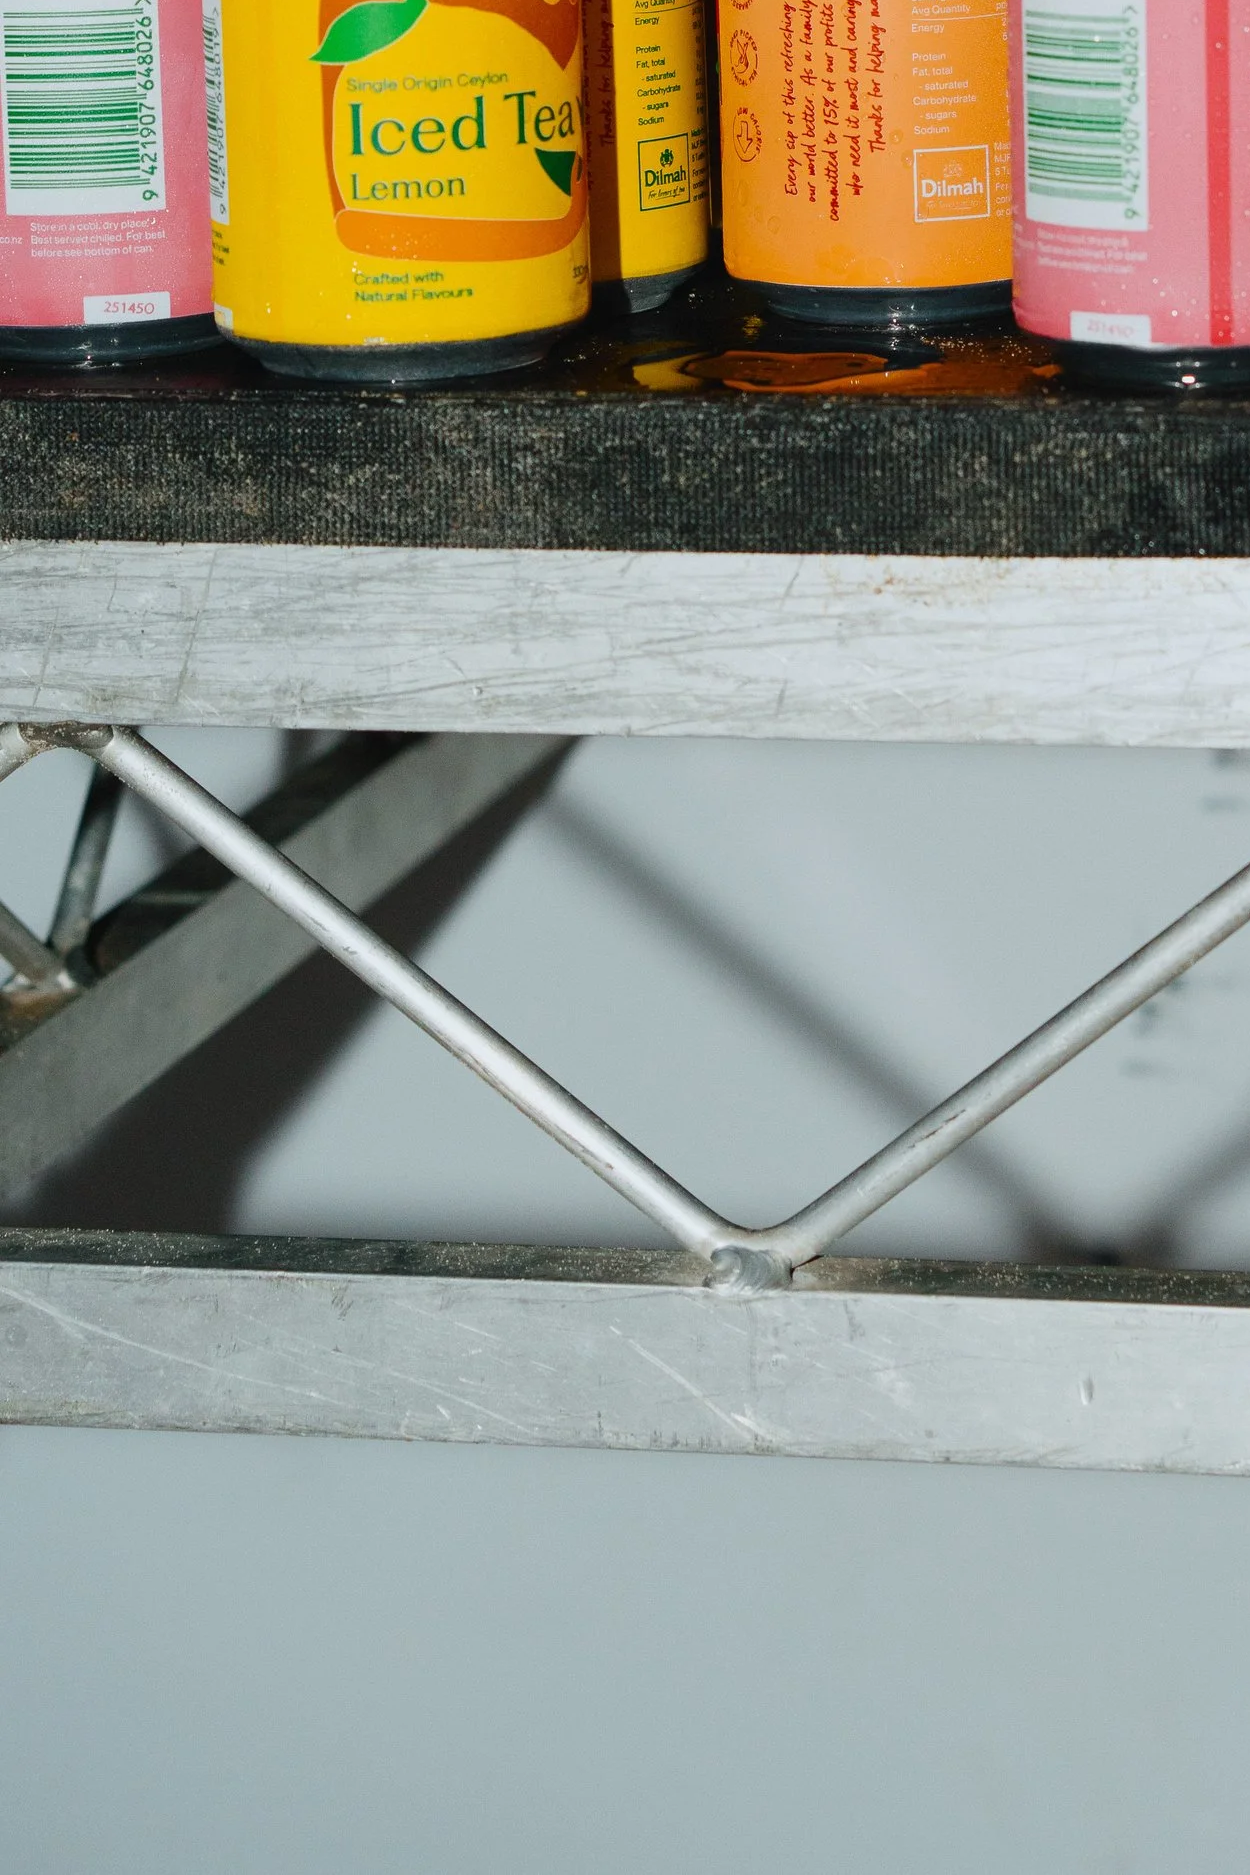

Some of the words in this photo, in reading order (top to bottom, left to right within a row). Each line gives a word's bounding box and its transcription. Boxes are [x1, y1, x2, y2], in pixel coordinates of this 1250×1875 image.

[635, 1, 648, 9] Avg
[912, 6, 930, 16] Avg
[932, 4, 970, 15] Quantity
[635, 17, 660, 26] Energy
[820, 3, 838, 46] profits
[912, 23, 944, 33] Energy
[779, 2, 796, 72] refreshing
[136, 16, 154, 91] 648026
[636, 45, 660, 54] Protein
[804, 50, 812, 61] a
[865, 23, 886, 73] helping
[652, 57, 666, 67] total
[825, 53, 833, 73] our
[840, 47, 857, 73] and
[912, 52, 946, 62] Protein
[646, 71, 676, 82] saturated
[800, 69, 817, 85] As
[932, 66, 952, 75] total
[347, 77, 398, 92] Single
[403, 74, 452, 91] Origin
[457, 71, 508, 88] Ceylon
[821, 79, 836, 92] of
[868, 79, 882, 97] for
[924, 79, 969, 91] saturated
[637, 84, 680, 97] Carbohydrate
[781, 79, 795, 106] this
[844, 78, 858, 110] most
[647, 101, 668, 111] sugars
[913, 95, 976, 106] Carbohydrate
[782, 111, 795, 124] of
[802, 93, 816, 137] better.
[822, 96, 838, 125] 15%
[925, 110, 956, 121] sugars
[348, 95, 487, 157] Iced
[503, 90, 575, 145] Tea
[638, 116, 664, 126] Sodium
[845, 116, 859, 129] it
[868, 105, 886, 153] Thanks
[824, 131, 837, 145] to
[914, 125, 950, 135] Sodium
[140, 102, 157, 175] 421907
[784, 131, 798, 149] sip
[843, 135, 860, 167] need
[801, 144, 816, 176] world
[644, 165, 686, 187] Dilmah
[784, 155, 802, 195] Every
[351, 173, 466, 201] Lemon
[822, 150, 839, 221] committed
[846, 173, 863, 195] who
[921, 177, 984, 198] Dilmah
[808, 182, 816, 203] our
[30, 223, 58, 232] Store
[103, 221, 119, 231] dry
[30, 235, 52, 245] Best
[55, 235, 88, 245] served
[84, 246, 120, 255] bottom
[354, 272, 409, 286] Crafted
[414, 270, 444, 285] with
[354, 289, 407, 303] Natural
[412, 287, 472, 301] Flavours
[104, 301, 155, 315] 251450
